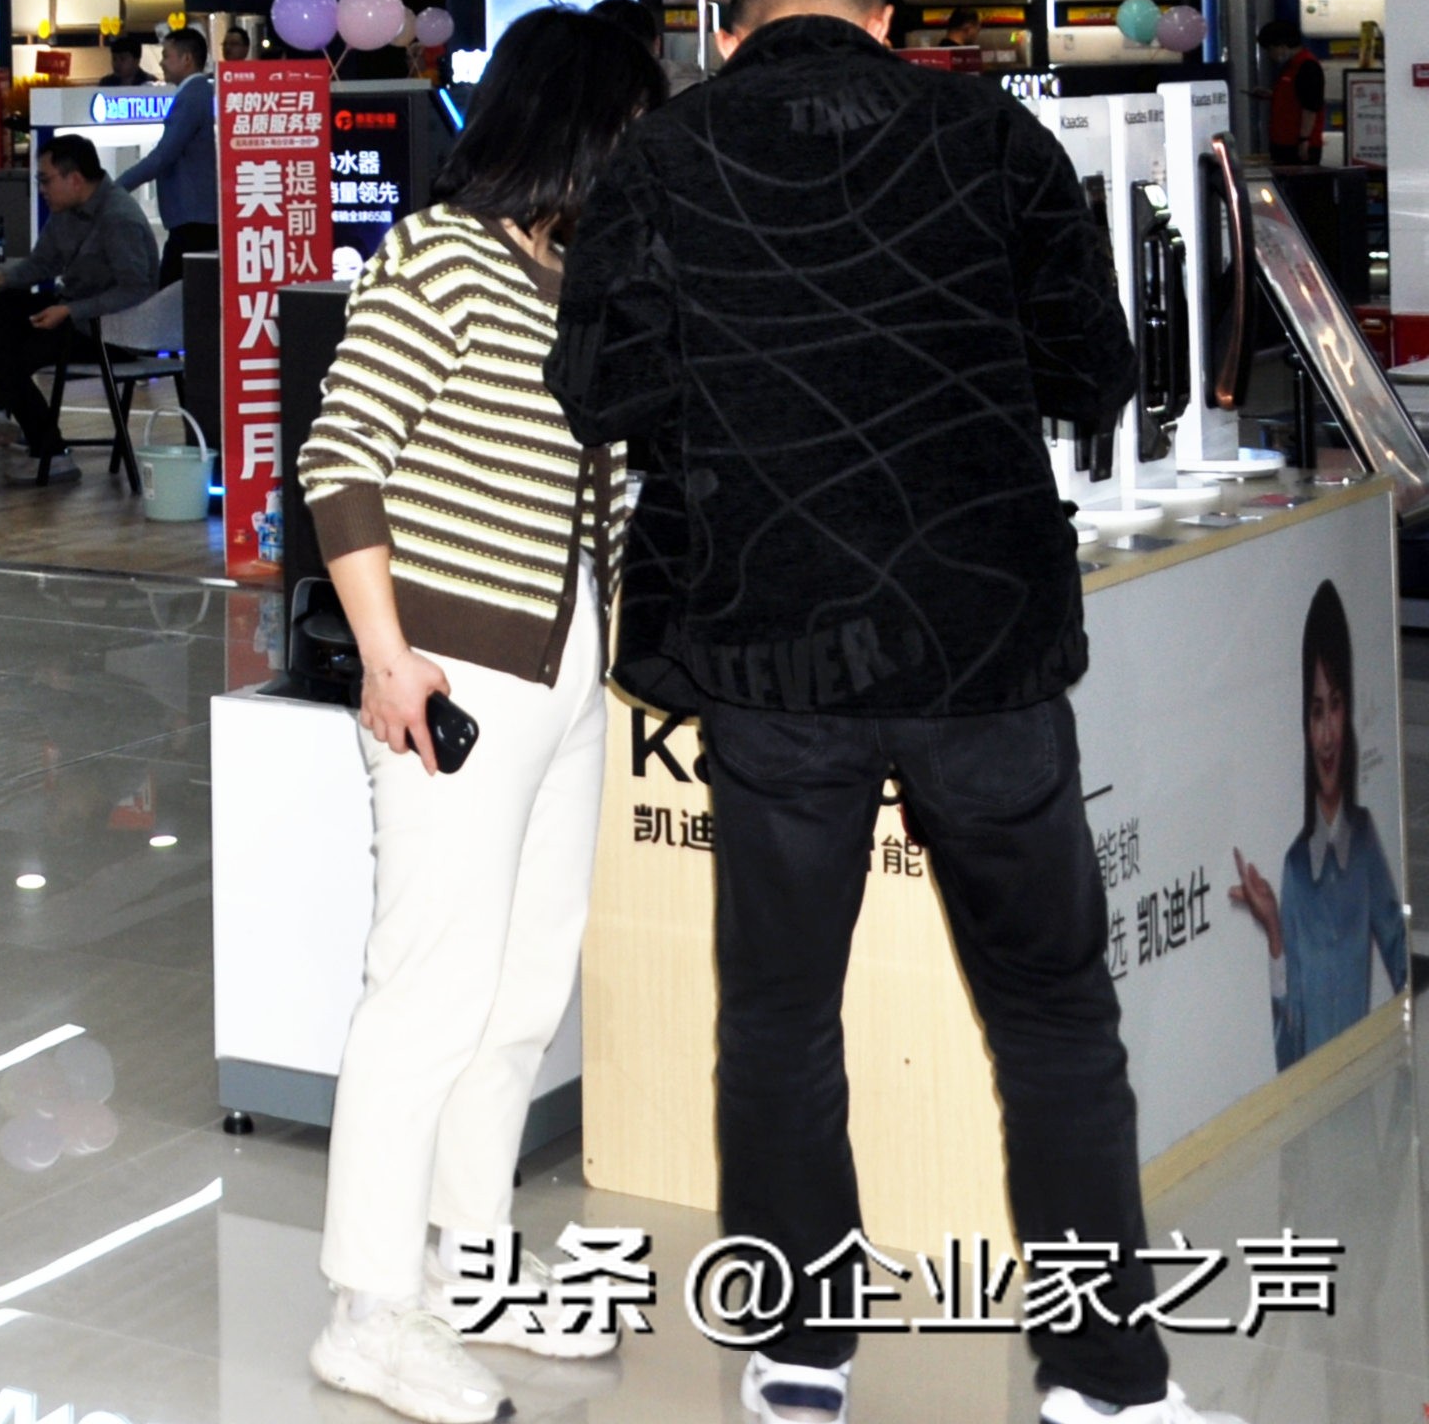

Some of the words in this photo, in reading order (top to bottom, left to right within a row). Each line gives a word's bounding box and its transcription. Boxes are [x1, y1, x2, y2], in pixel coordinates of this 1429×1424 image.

[225, 90, 315, 113] 美的火三月
[232, 112, 323, 135] 品质服务季
[1060, 116, 1089, 129] Kaadas
[285, 159, 319, 279] 提前认
[235, 160, 285, 480] 美的火三月
[1136, 864, 1211, 967] 凯迪仕
